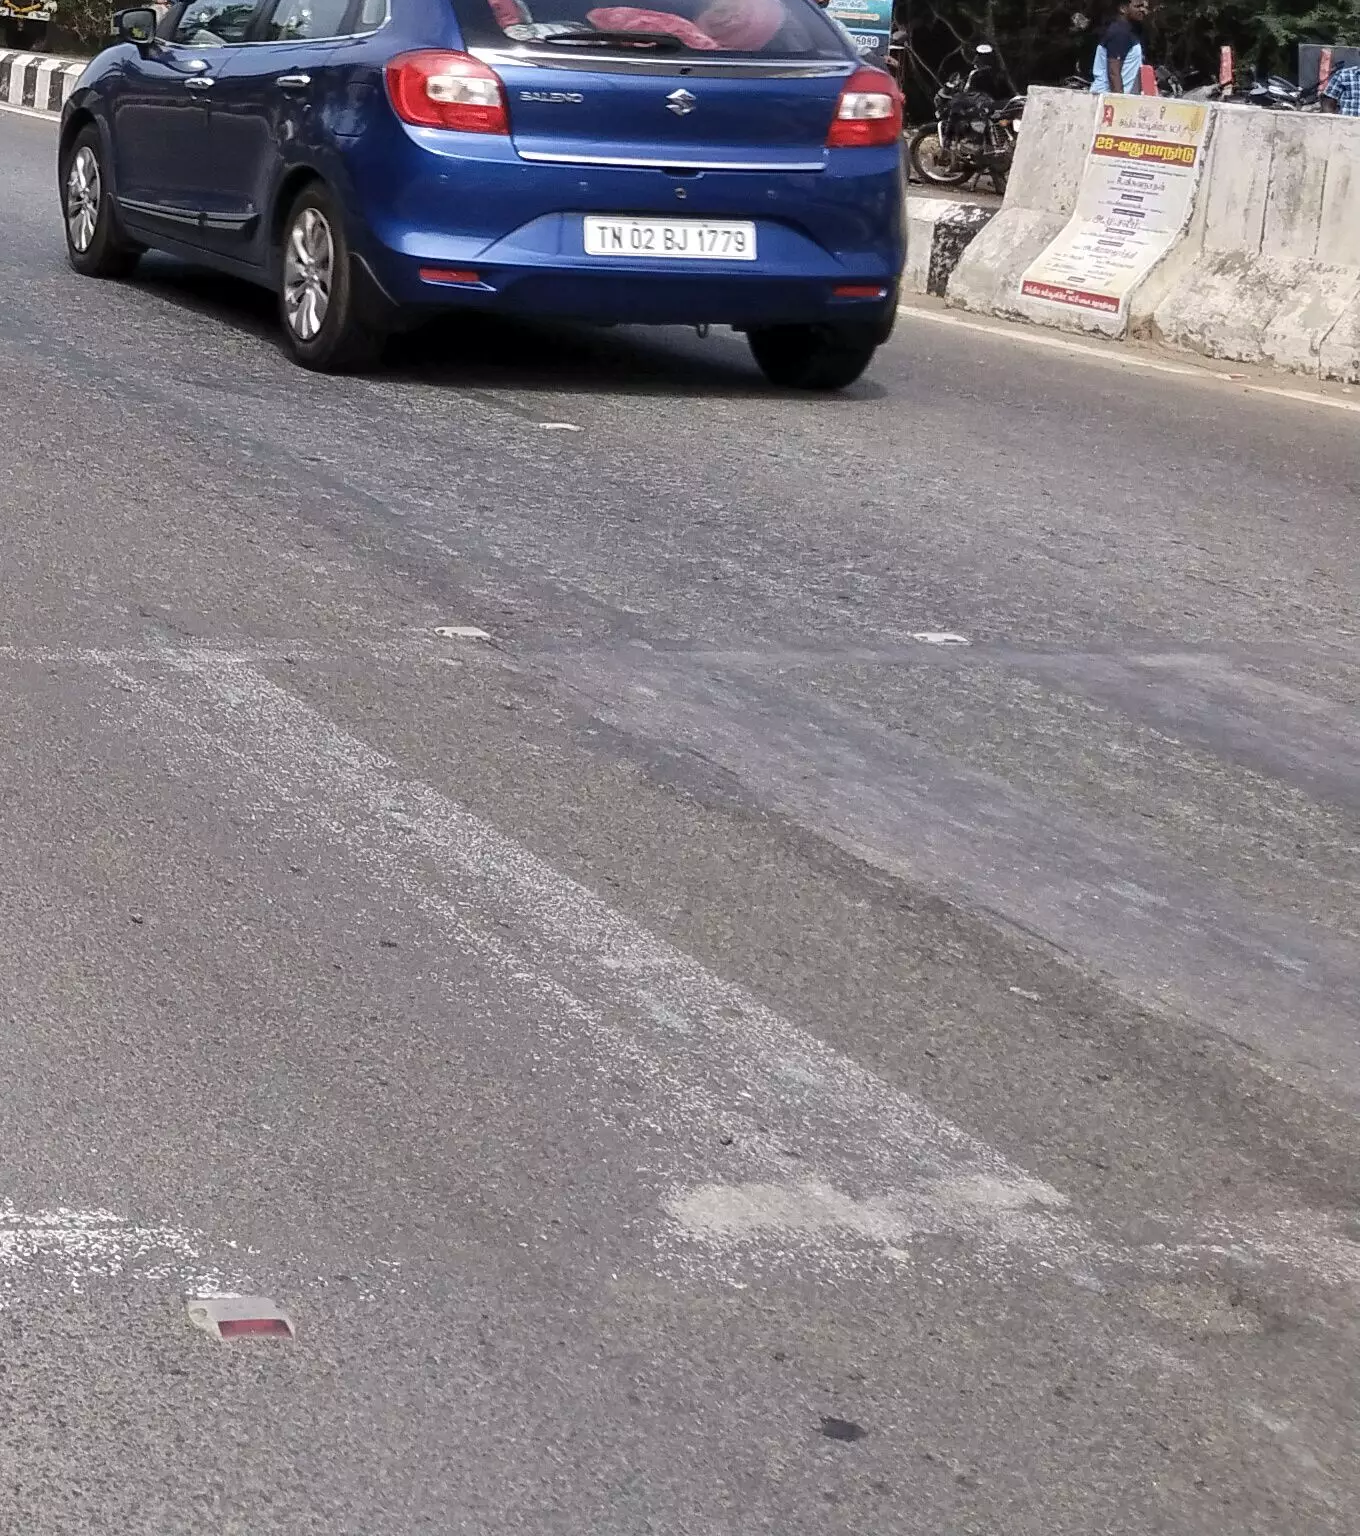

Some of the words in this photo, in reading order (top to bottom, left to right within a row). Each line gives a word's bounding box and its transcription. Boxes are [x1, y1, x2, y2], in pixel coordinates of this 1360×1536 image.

[520, 91, 584, 103] BALENO
[597, 225, 623, 249] TN
[630, 227, 655, 251] 02
[664, 228, 688, 251] BJ
[698, 229, 746, 253] 1779
